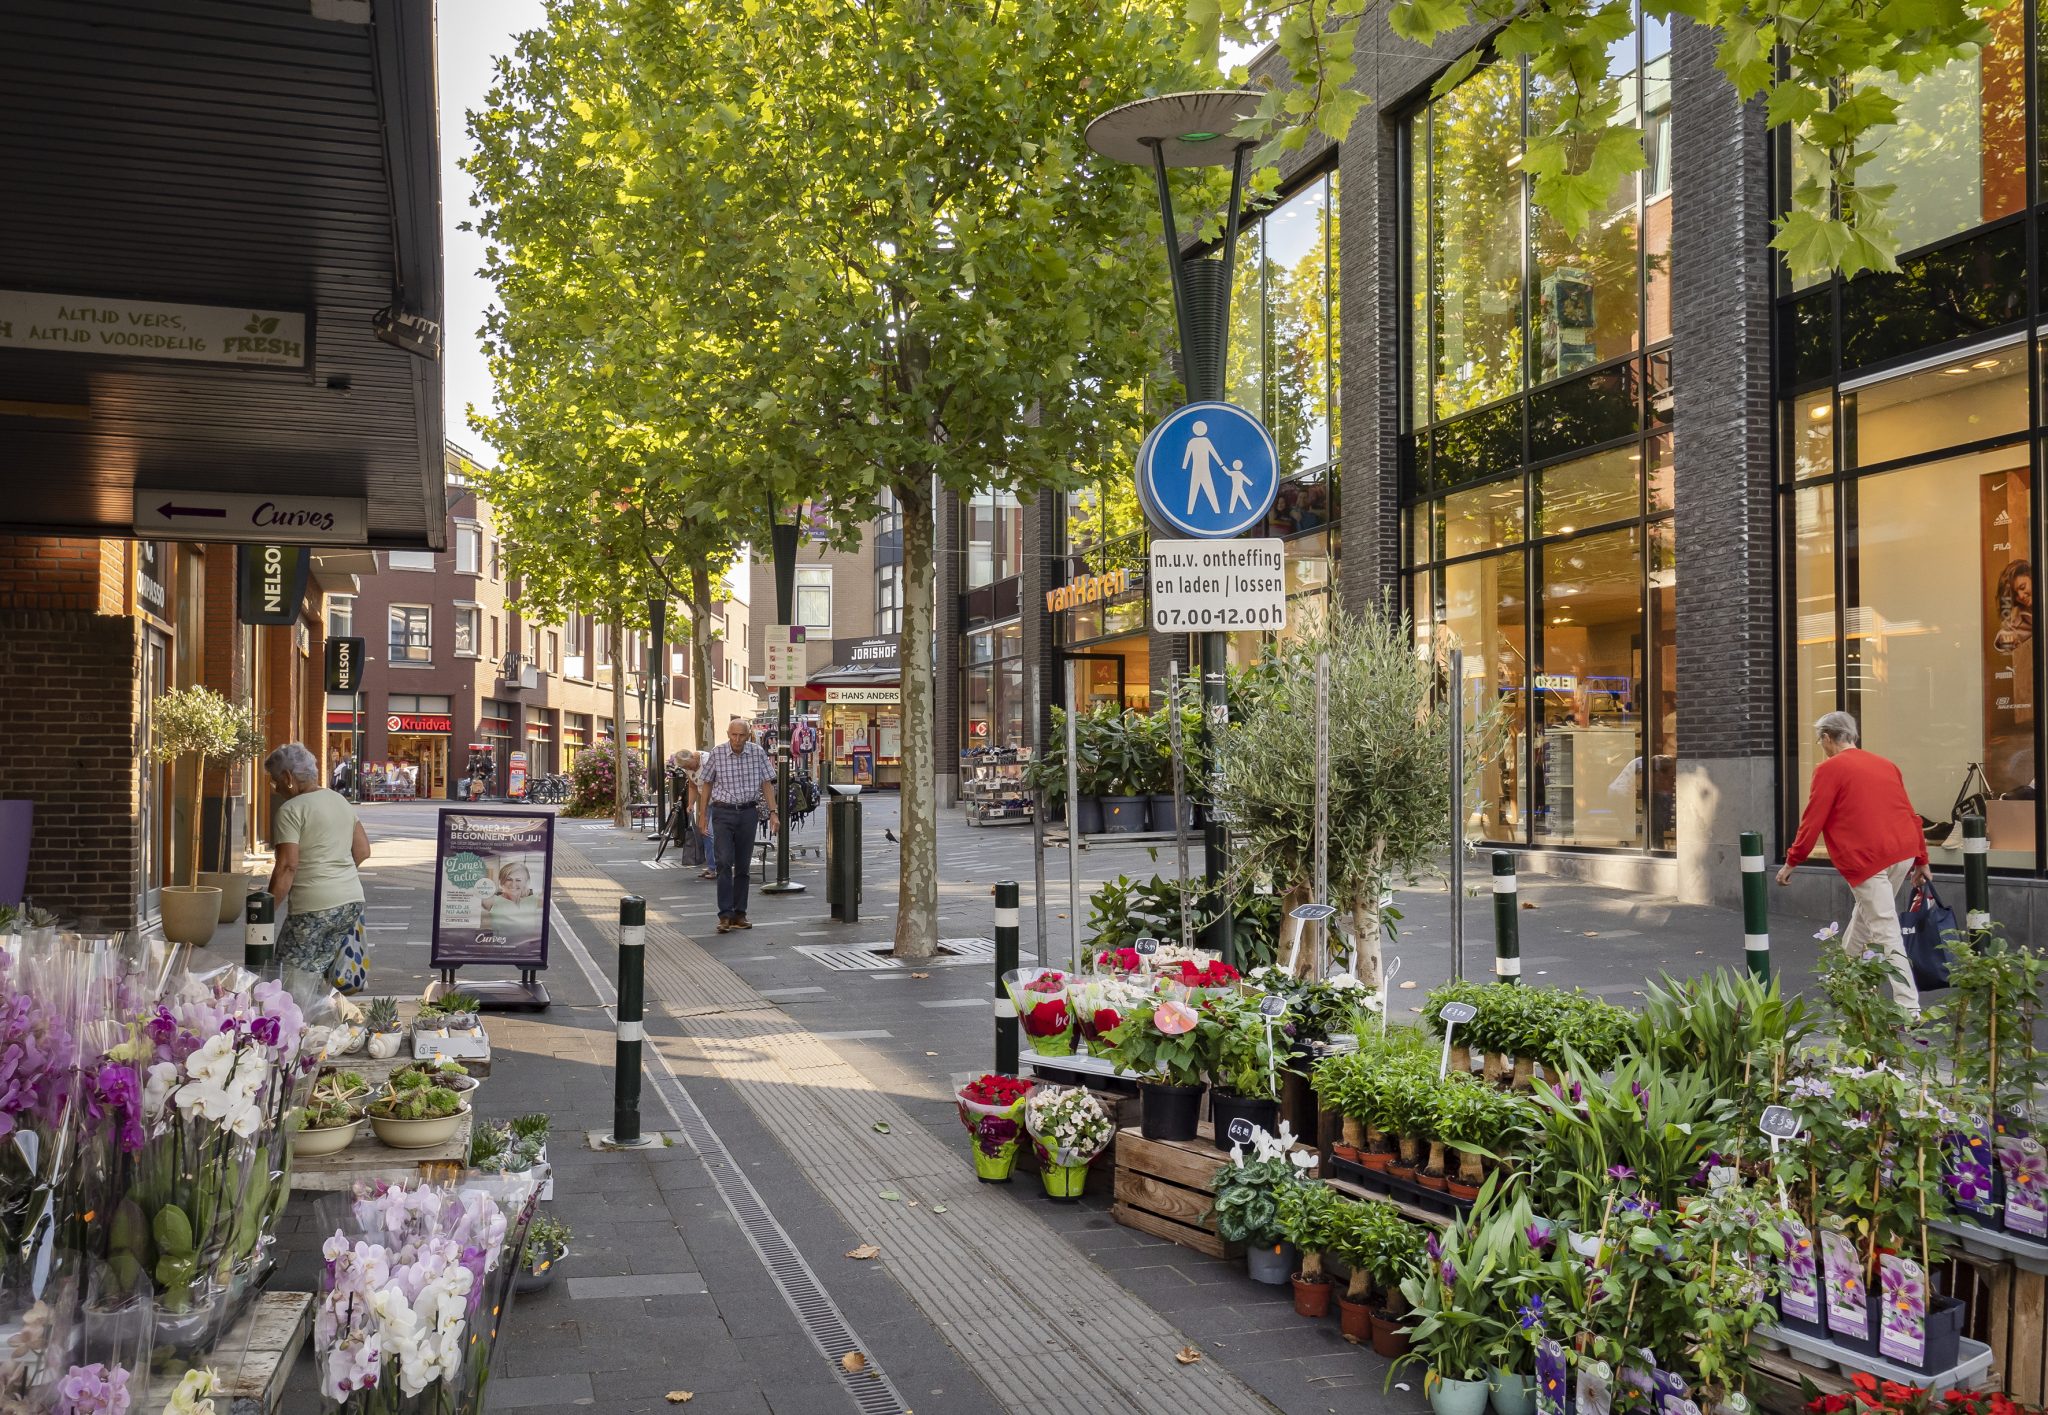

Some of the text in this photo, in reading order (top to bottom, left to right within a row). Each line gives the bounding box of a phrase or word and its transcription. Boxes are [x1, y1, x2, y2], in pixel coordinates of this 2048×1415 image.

[58, 306, 187, 331] ALTIJD VERS,
[29, 325, 91, 342] ALTIJD
[100, 331, 206, 352] VOORDELIG
[223, 336, 302, 358] FRESH
[252, 502, 334, 531] Curves
[1993, 543, 2011, 551] FILA
[1155, 549, 1281, 571] m.u.v. ontheffing
[264, 545, 282, 612] NELSO
[1156, 580, 1174, 594] en
[1179, 576, 1220, 593] laden
[1235, 576, 1282, 593] lossen
[1046, 568, 1127, 613] vanHaren
[851, 646, 897, 661] JORISHOF
[339, 643, 350, 689] NELSON
[842, 692, 899, 700] HANS ANDERS
[402, 717, 451, 731] Kruidvat
[451, 823, 464, 831] DE
[467, 823, 501, 832] ZOMER
[451, 832, 542, 843] BEGONNEN. NU JIJ!
[446, 858, 484, 873] Zomer
[454, 870, 479, 882] actie
[475, 933, 507, 945] Curves
